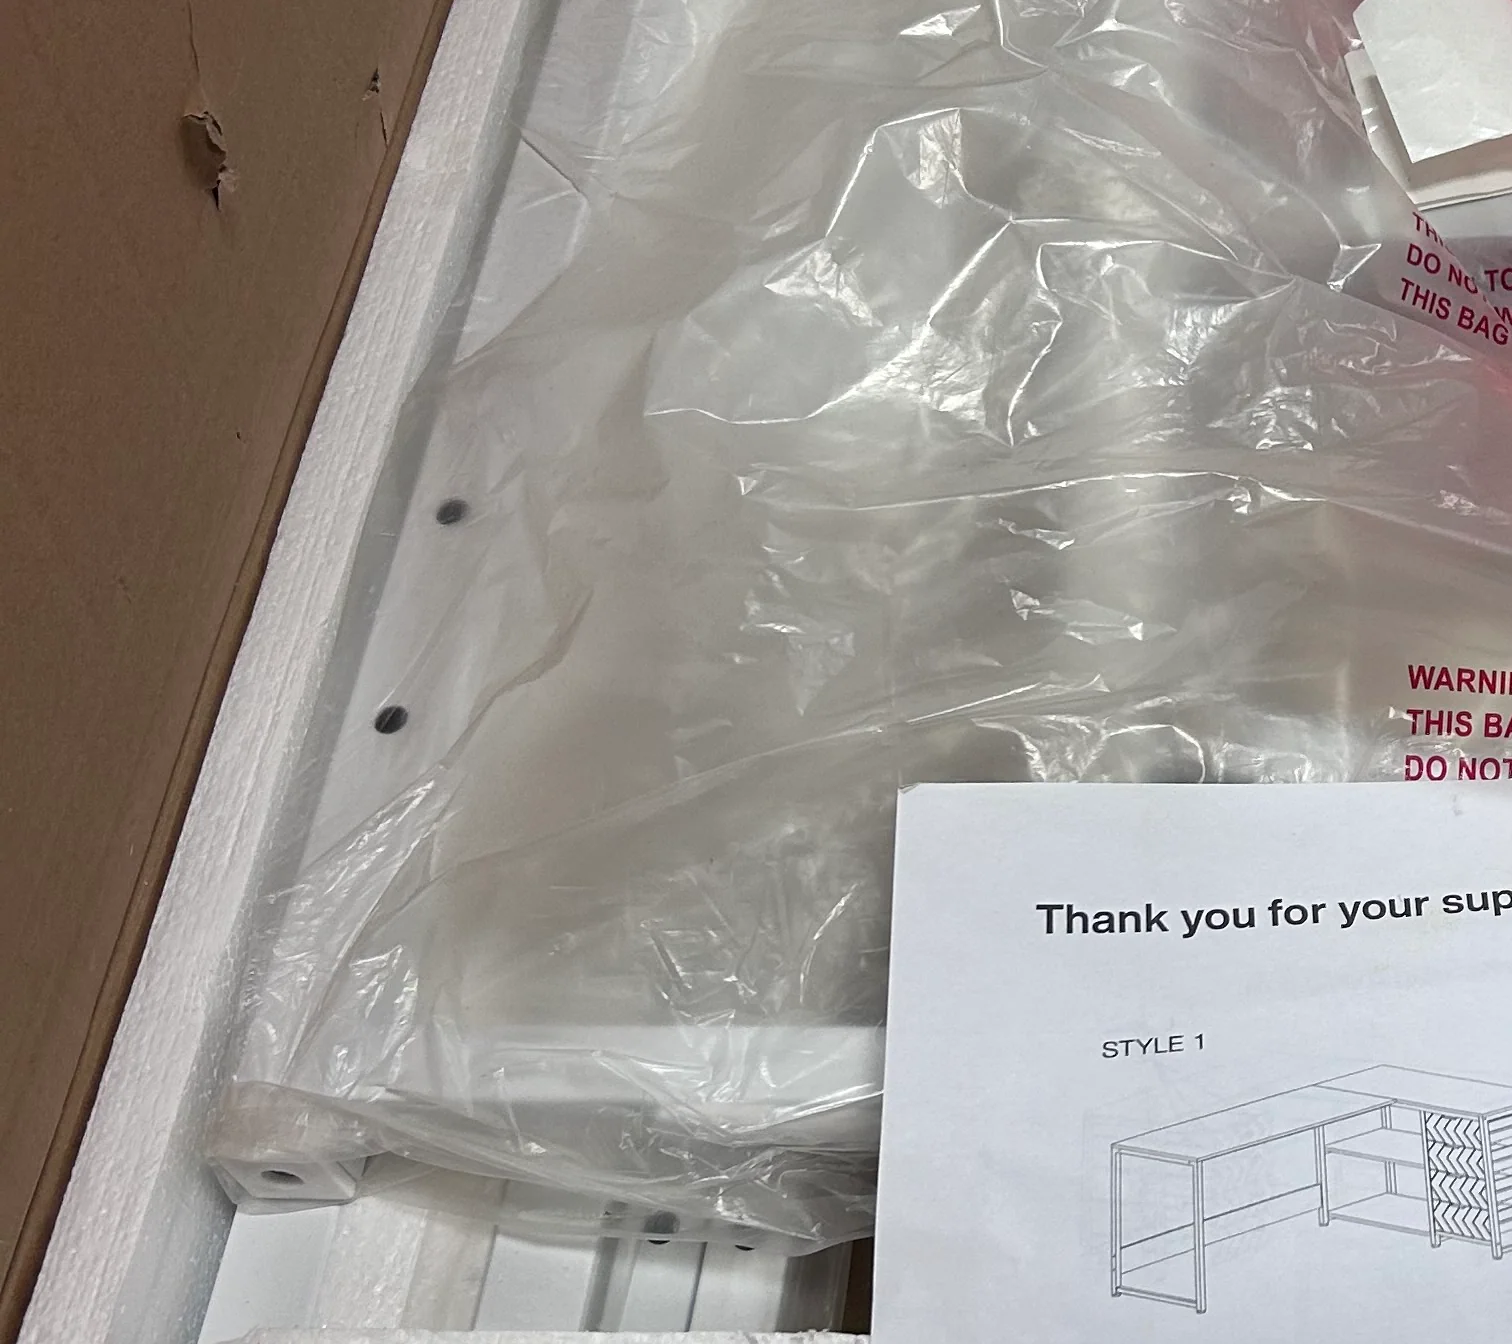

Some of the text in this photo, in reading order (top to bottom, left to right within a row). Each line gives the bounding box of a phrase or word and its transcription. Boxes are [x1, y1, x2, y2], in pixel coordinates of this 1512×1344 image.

[1406, 243, 1441, 274] DO
[1401, 277, 1510, 346] THIS BAG
[1406, 708, 1473, 738] THIS
[1404, 754, 1448, 781] DO
[1036, 902, 1169, 936] Thank
[1181, 905, 1257, 939] you
[1268, 898, 1327, 928] for
[1338, 892, 1430, 929] your
[1101, 1033, 1206, 1060] STYLE 1
